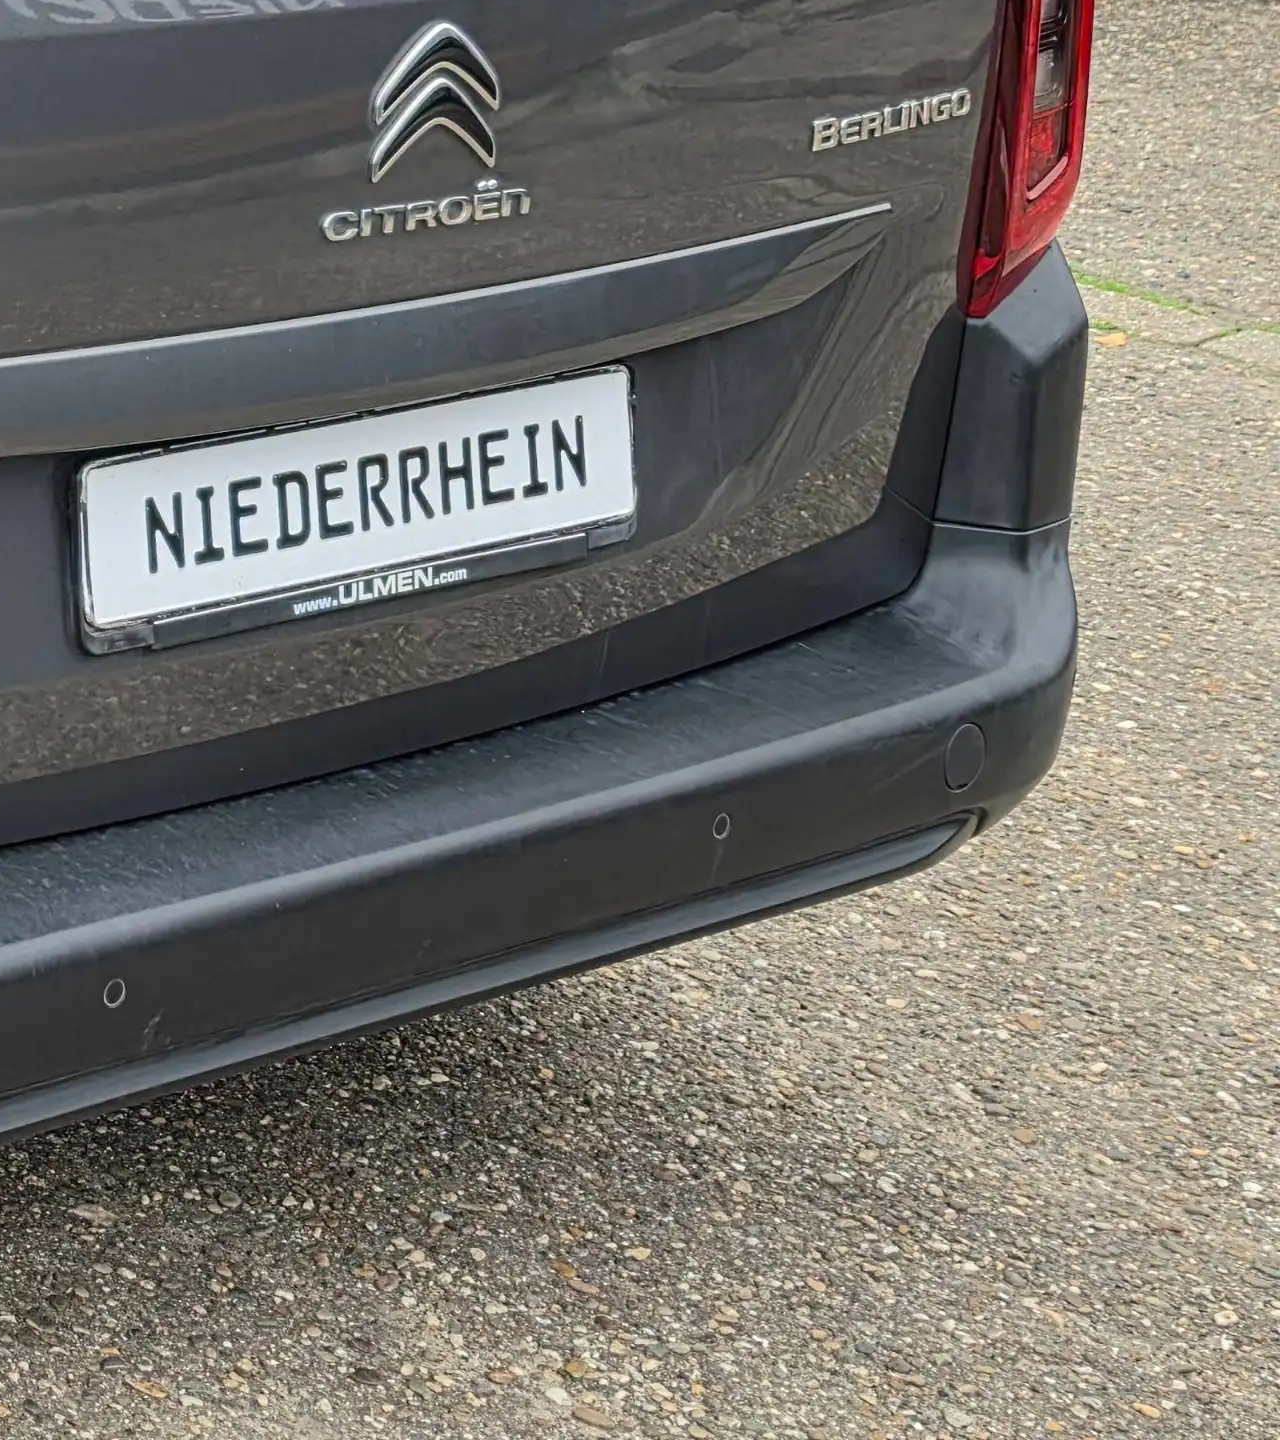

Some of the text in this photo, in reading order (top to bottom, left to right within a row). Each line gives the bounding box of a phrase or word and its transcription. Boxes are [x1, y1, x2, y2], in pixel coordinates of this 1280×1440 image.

[812, 87, 972, 152] BERLINGO
[144, 415, 588, 574] NIEDERRHEIN
[293, 566, 468, 616] www.ULMEN.com
